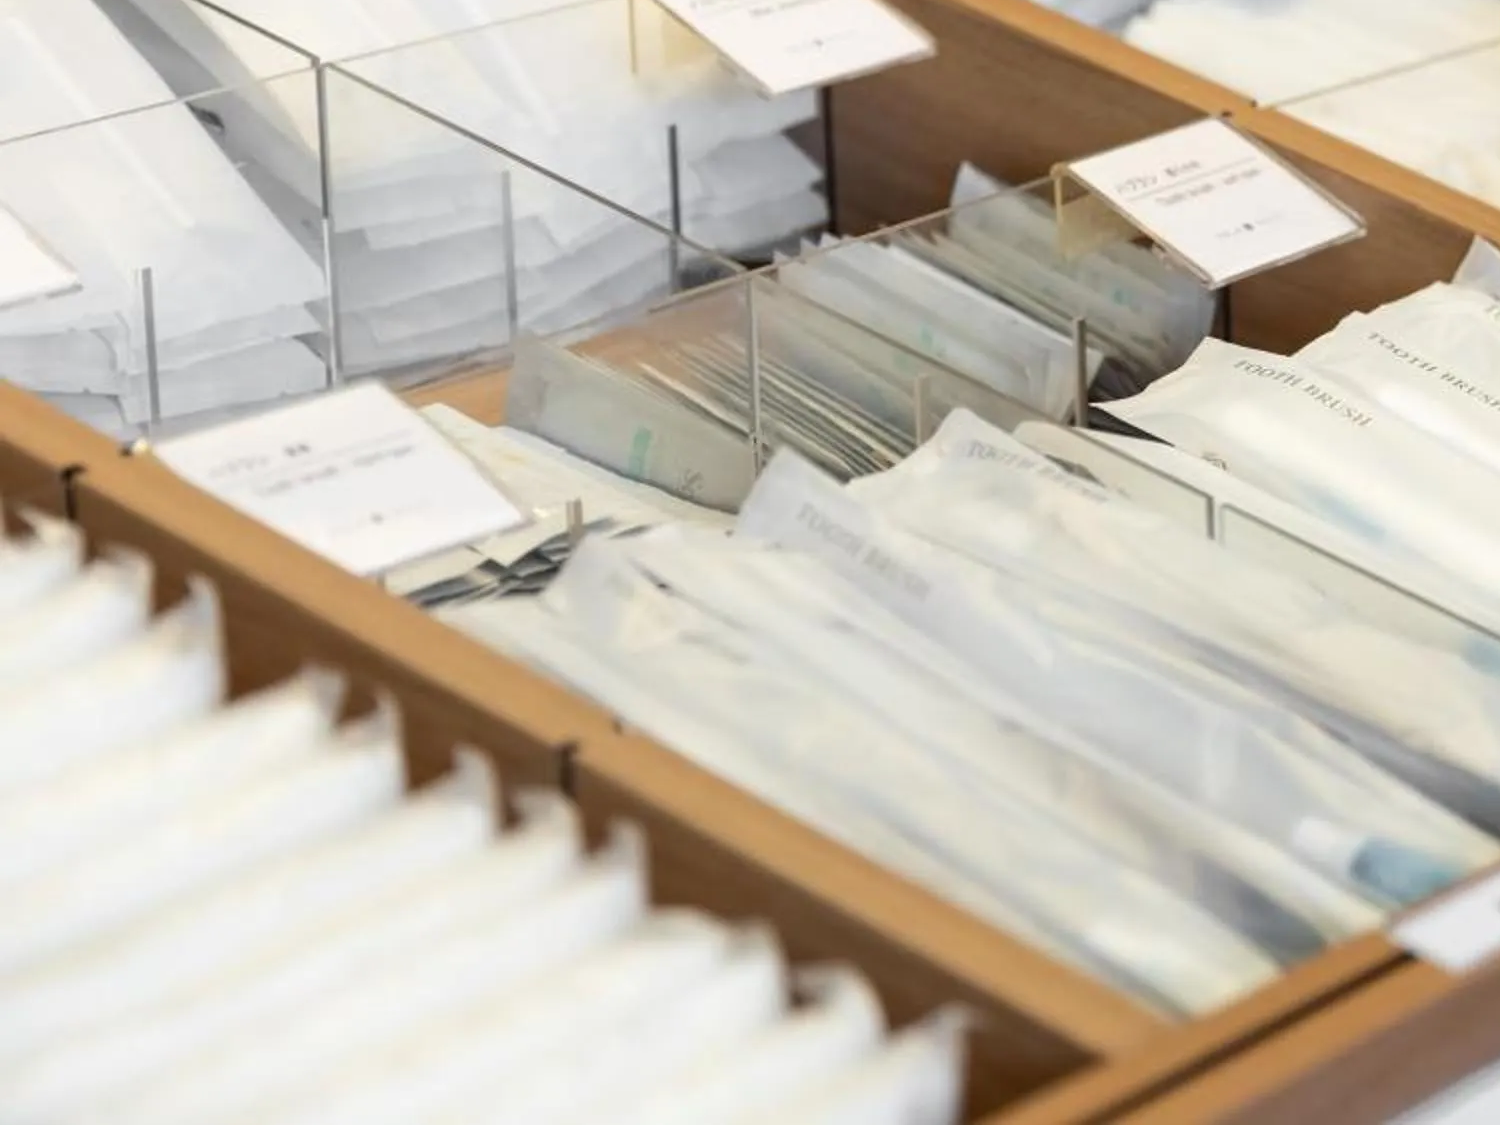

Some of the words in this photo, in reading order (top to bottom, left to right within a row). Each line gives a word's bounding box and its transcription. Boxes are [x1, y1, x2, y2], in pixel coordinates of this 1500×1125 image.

[1367, 331, 1437, 377] TOOTH
[1233, 358, 1302, 391] TOOTH
[1303, 379, 1373, 429] BRUSH
